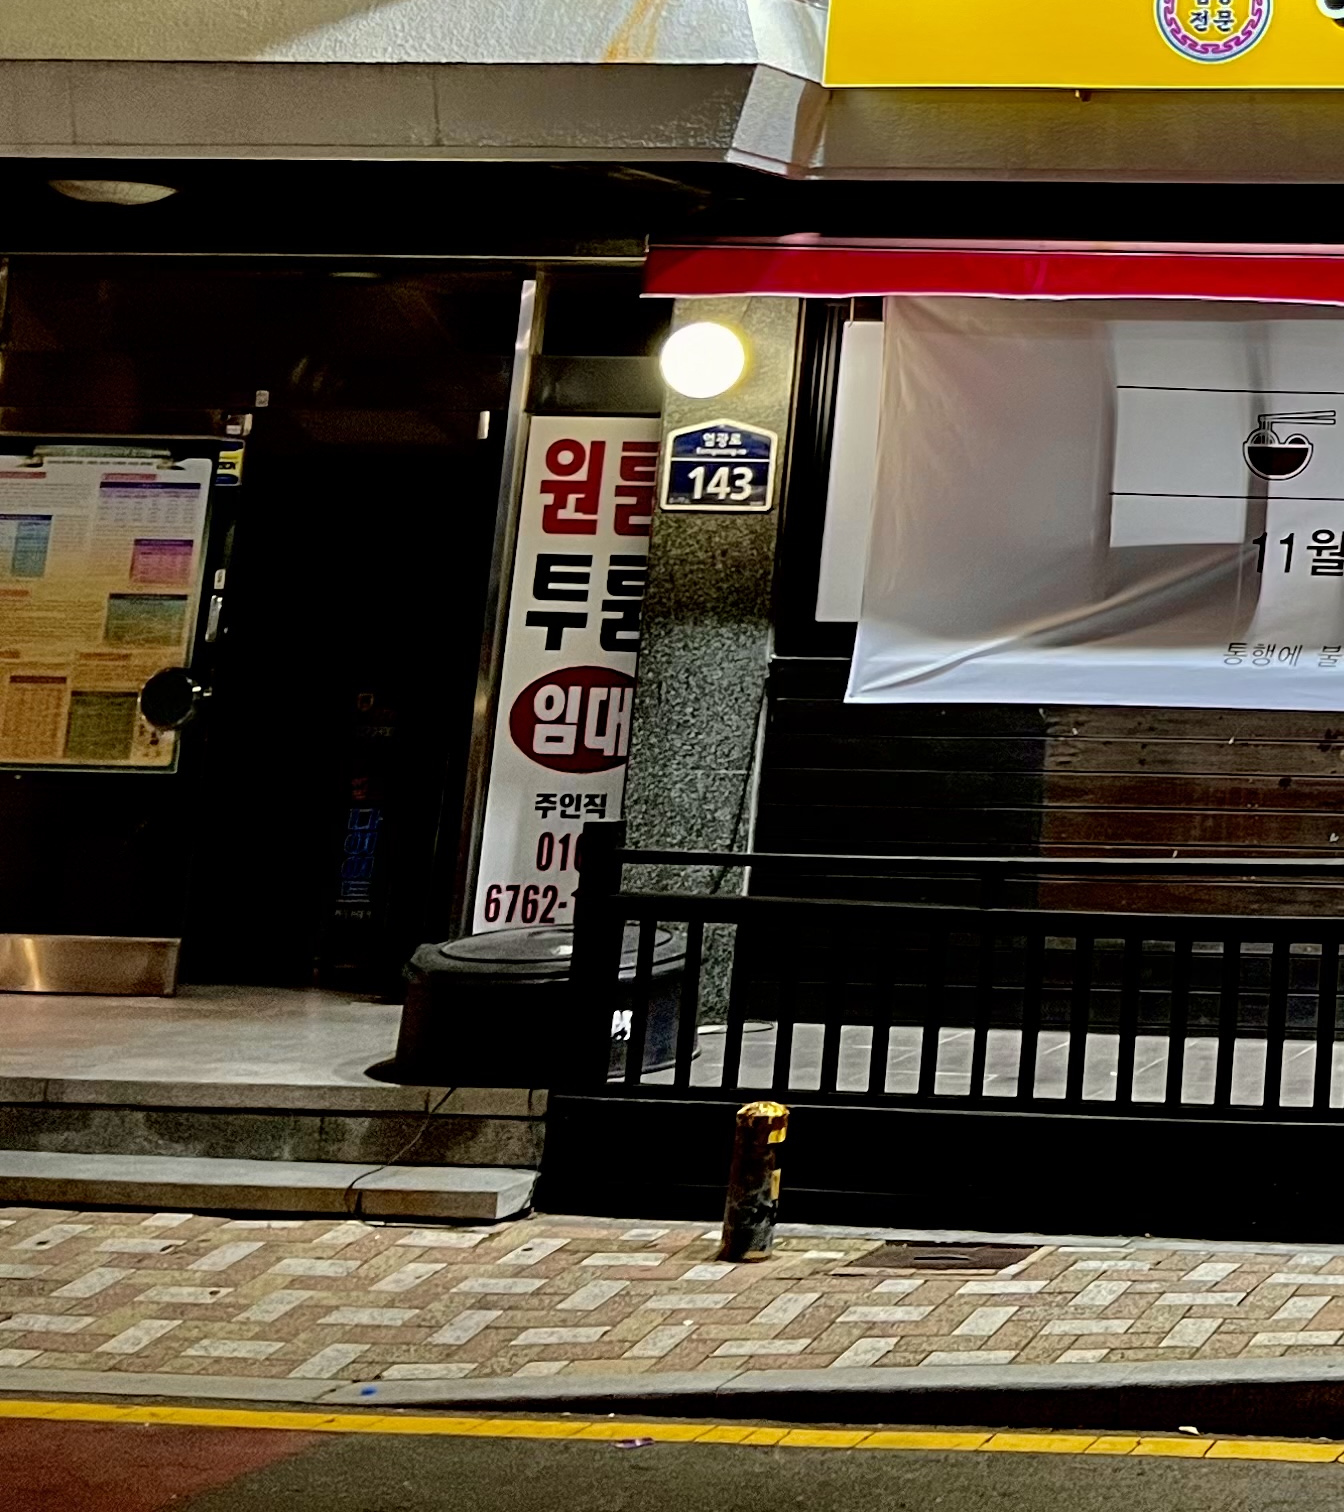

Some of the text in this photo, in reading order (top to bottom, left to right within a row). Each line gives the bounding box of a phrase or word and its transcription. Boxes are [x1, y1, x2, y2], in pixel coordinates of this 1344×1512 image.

[1189, 11, 1235, 32] 전문
[687, 466, 753, 501] 143
[1222, 642, 1303, 668] 통행에
[532, 683, 634, 756] 임대
[535, 793, 607, 819] 주인직
[484, 884, 577, 924] 6762-
